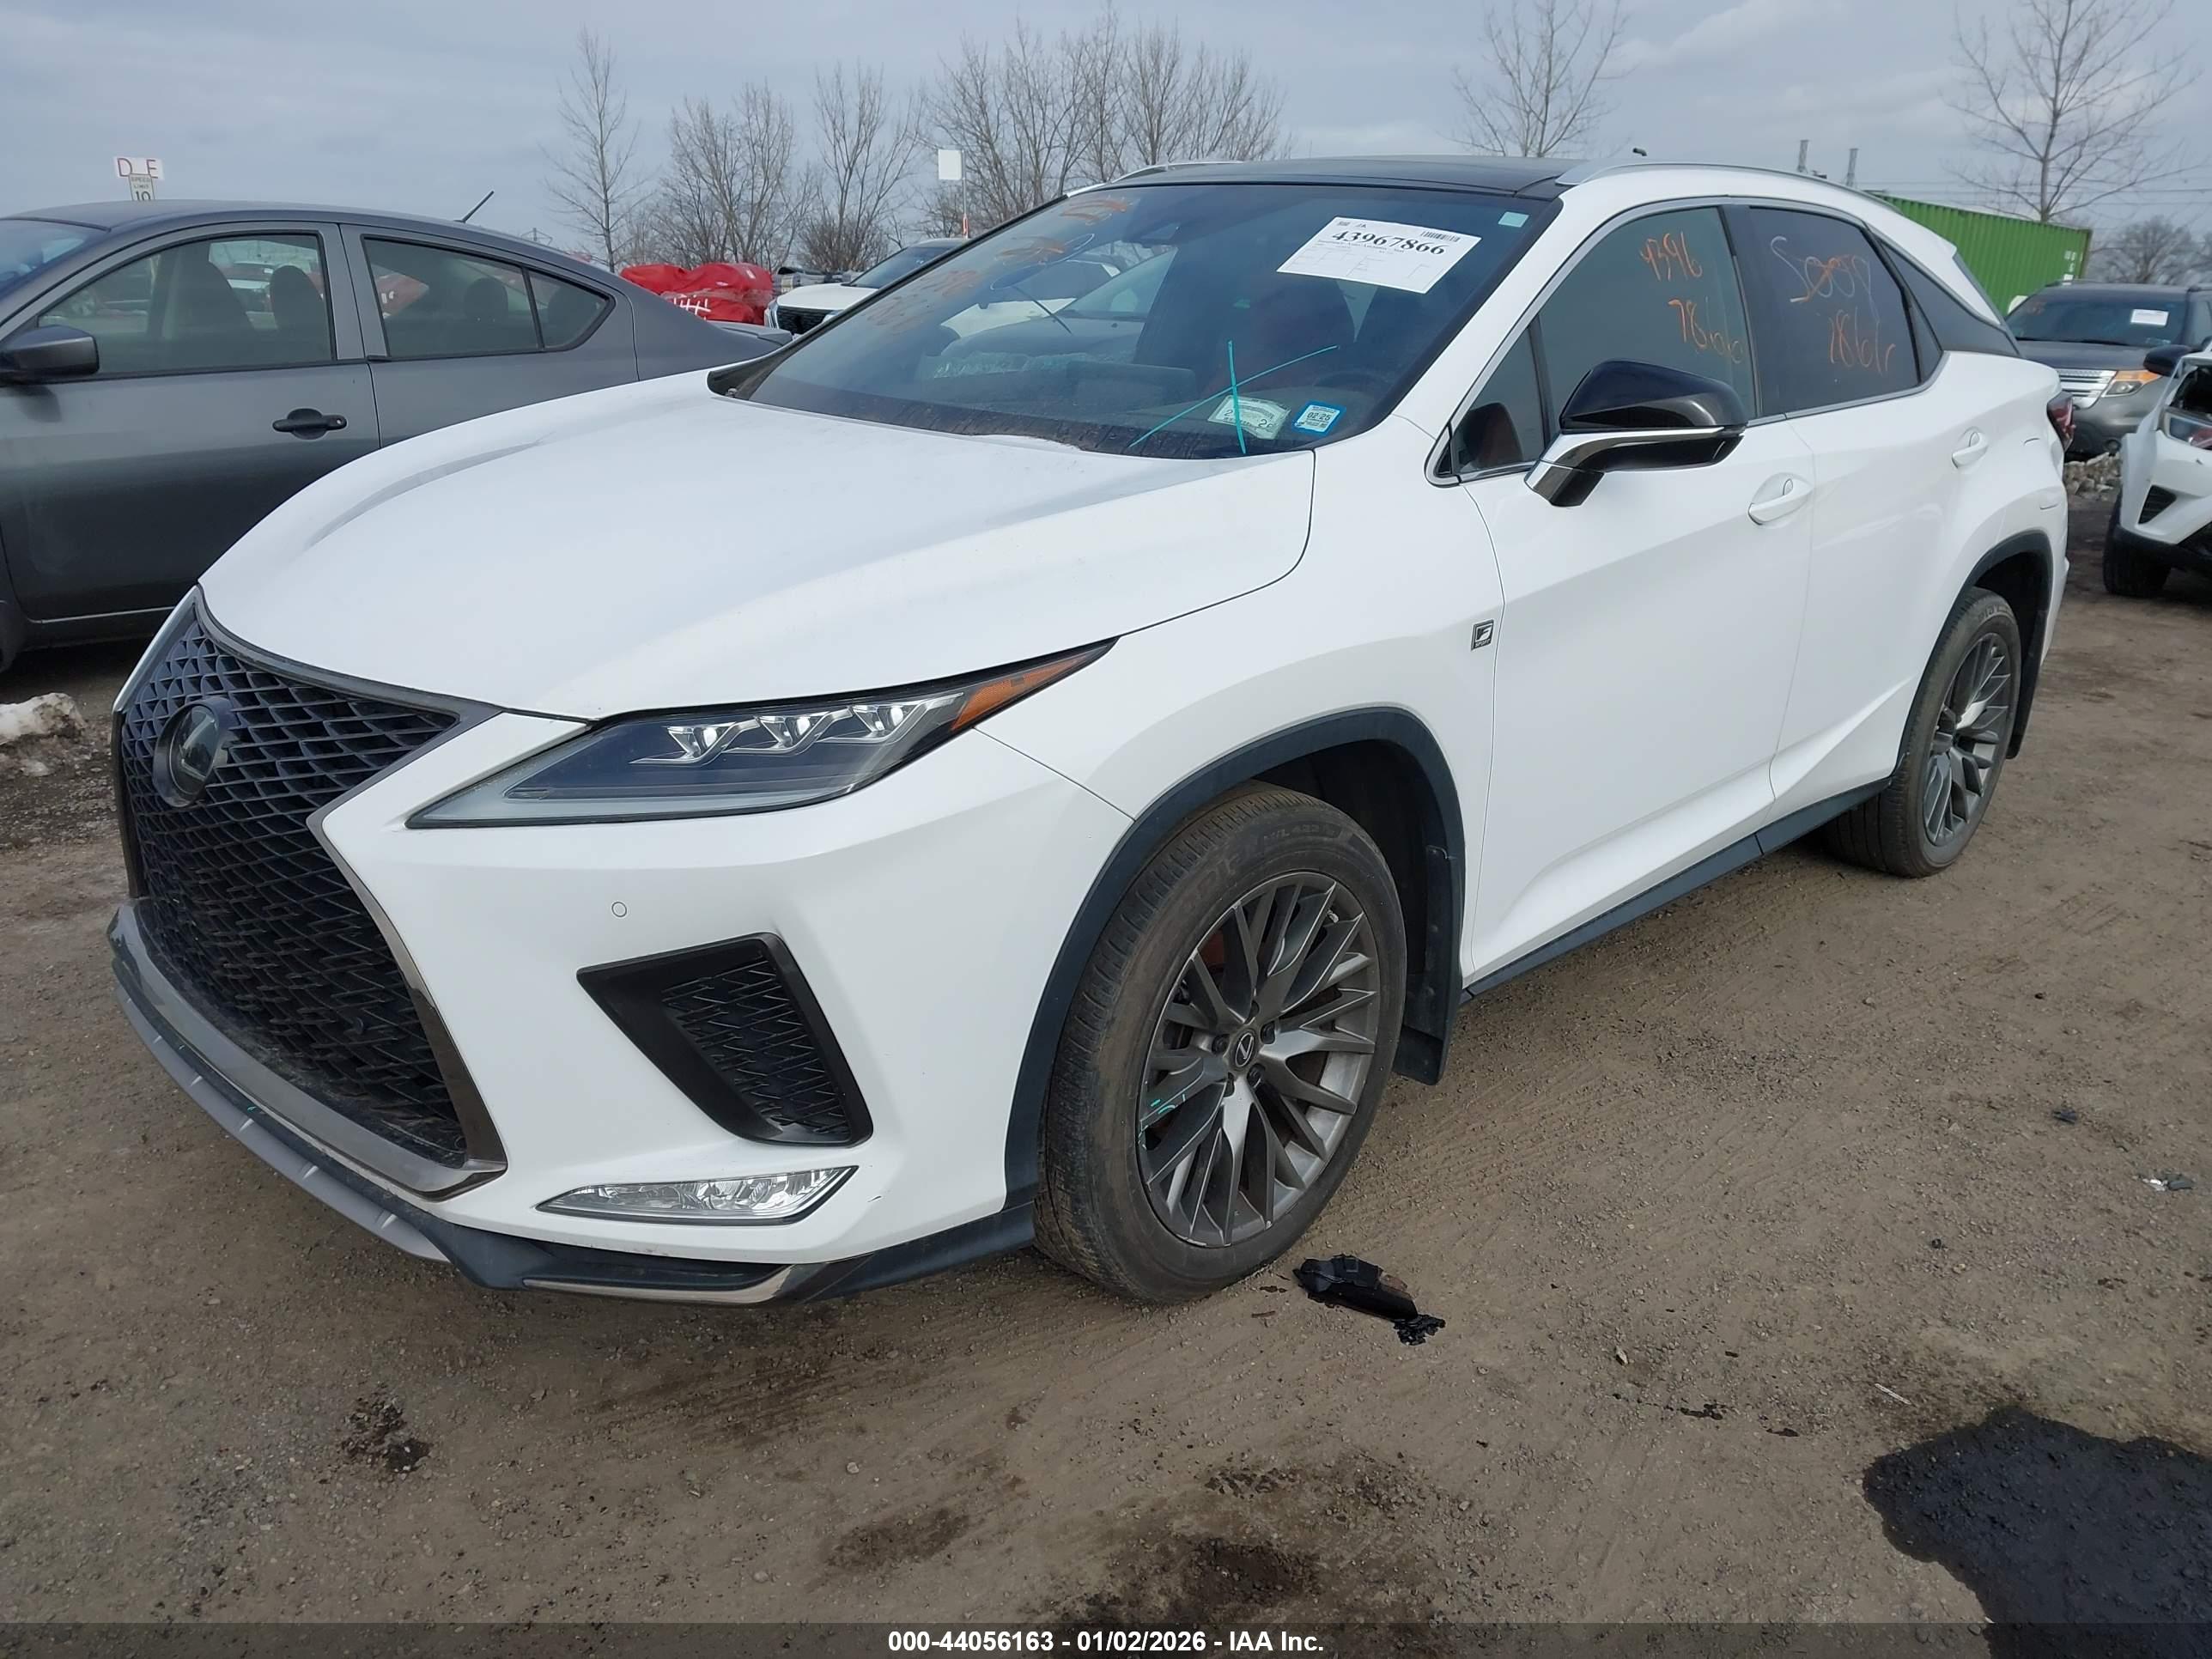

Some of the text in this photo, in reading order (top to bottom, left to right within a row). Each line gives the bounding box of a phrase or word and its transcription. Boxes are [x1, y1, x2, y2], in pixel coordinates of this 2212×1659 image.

[117, 158, 159, 179] D E
[135, 191, 151, 201] 10
[1332, 229, 1449, 256] 43967866
[1474, 639, 1491, 647] SPORT
